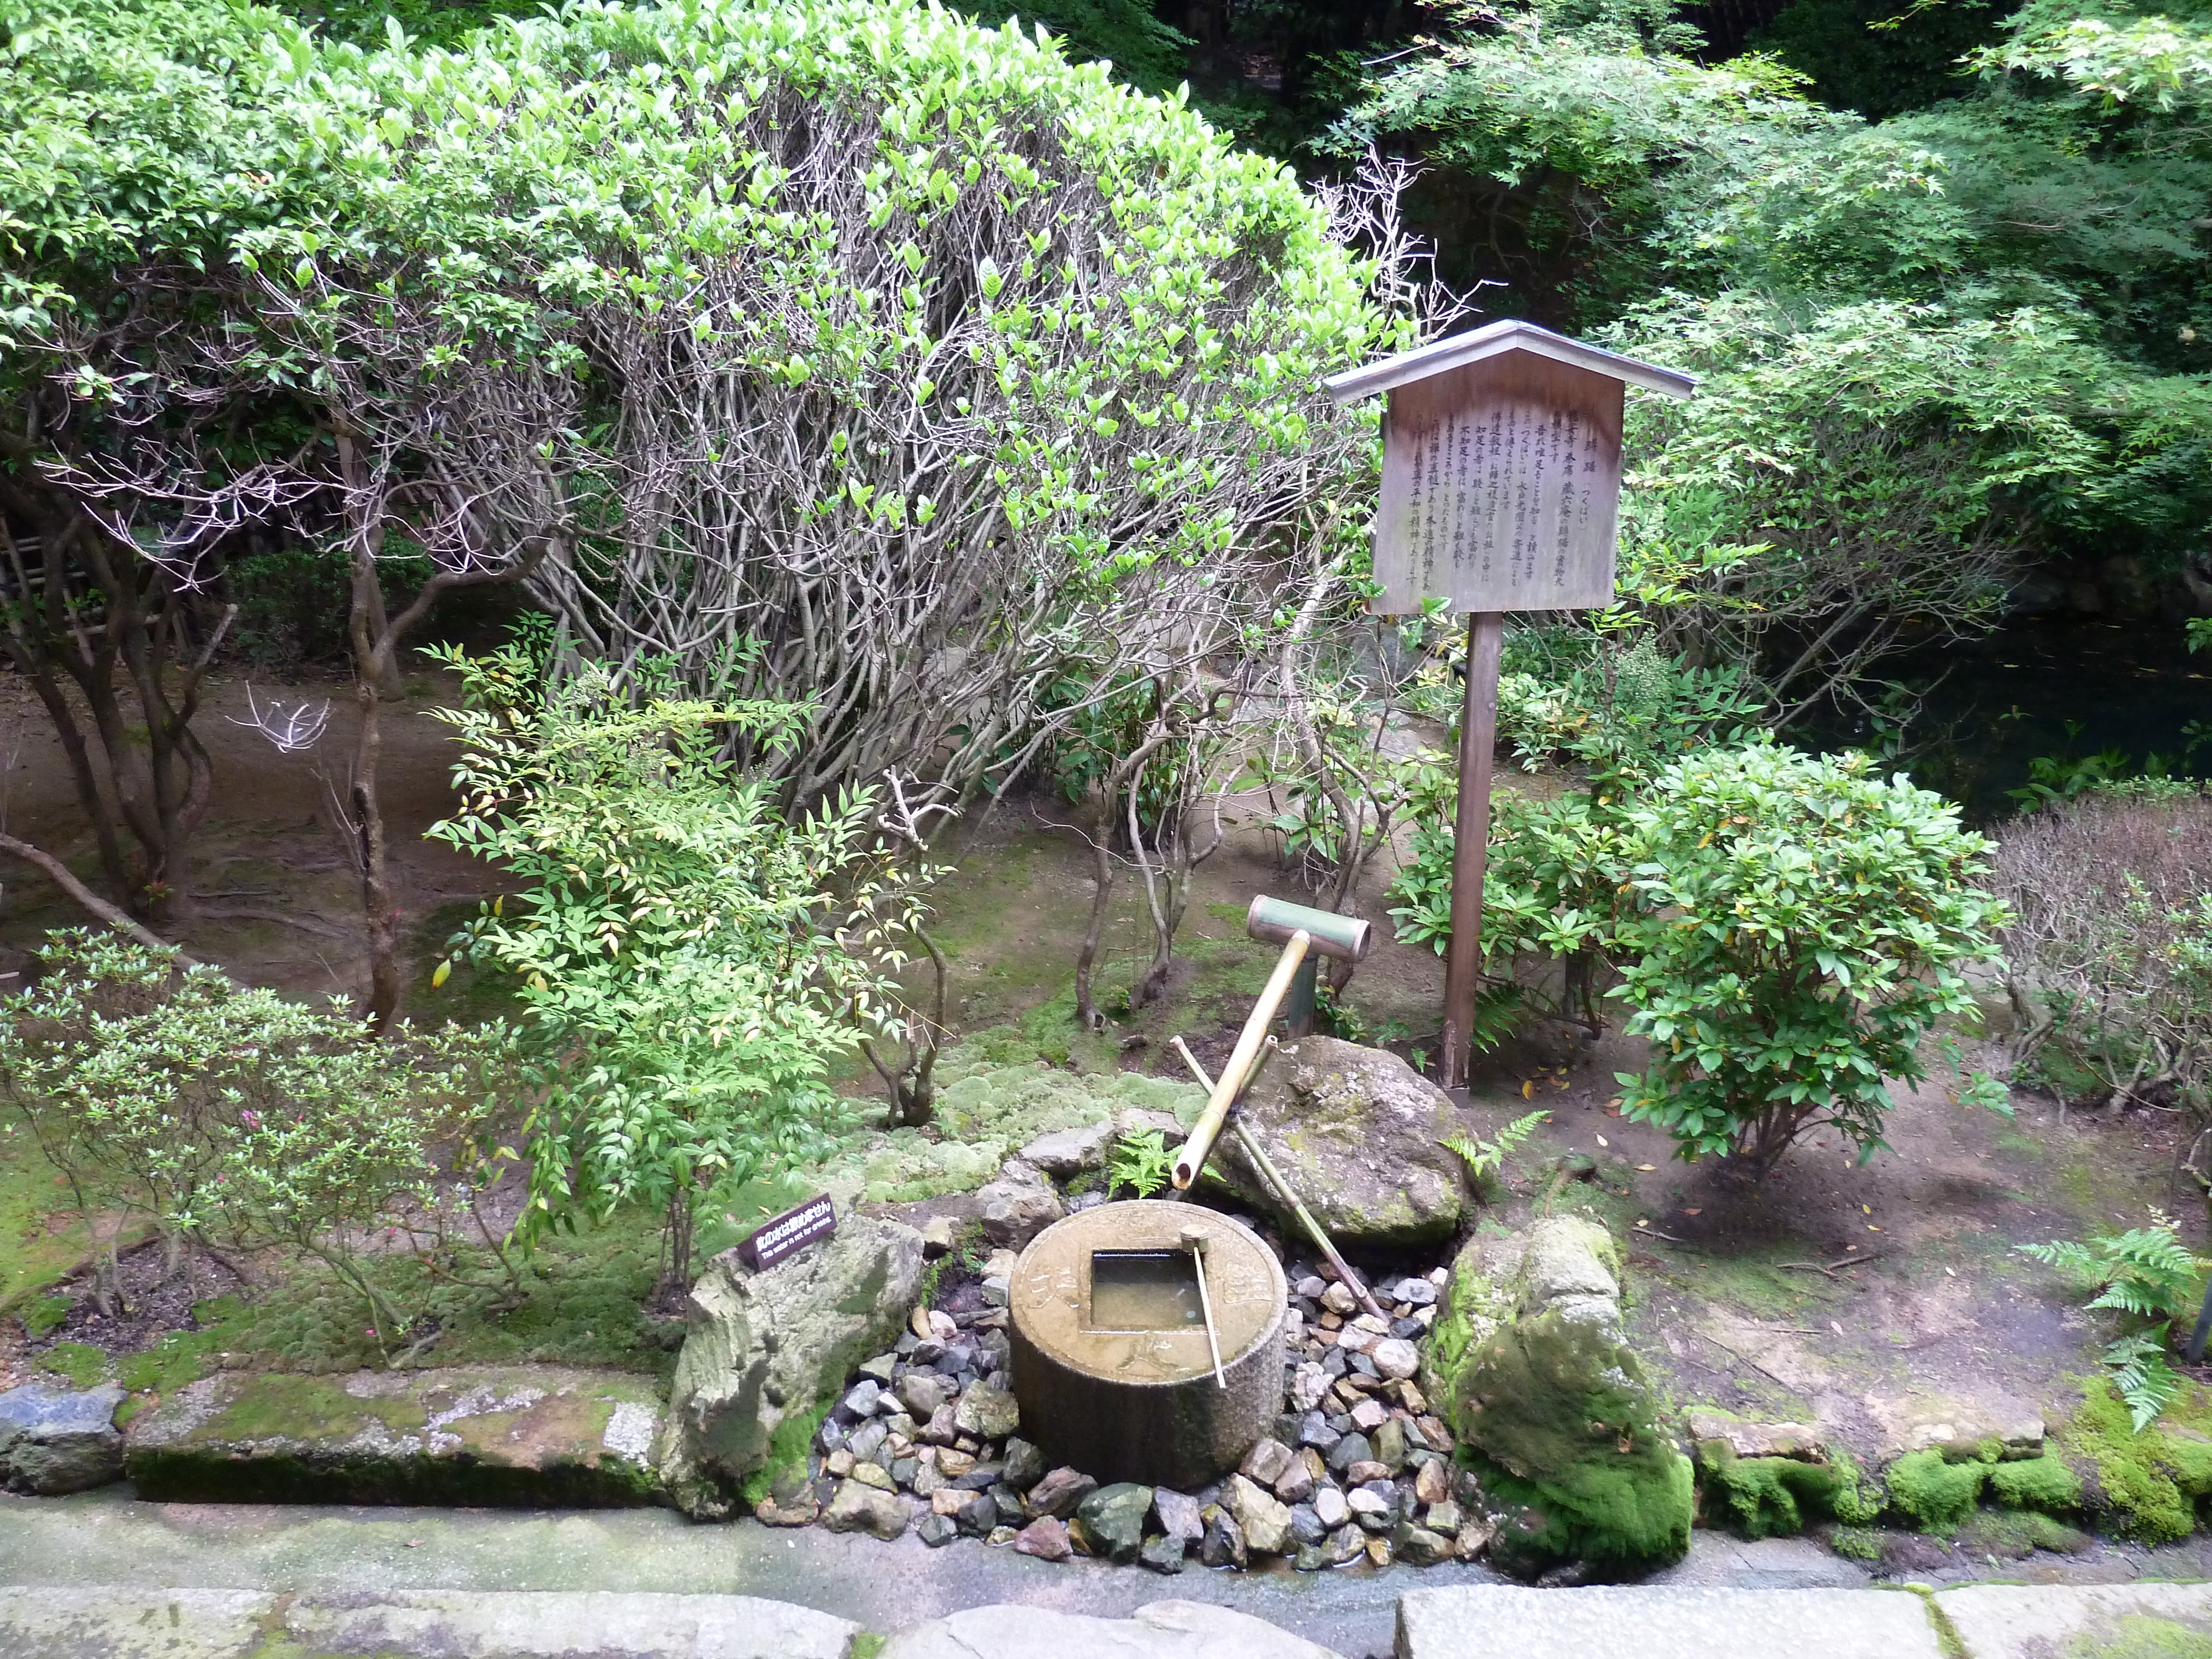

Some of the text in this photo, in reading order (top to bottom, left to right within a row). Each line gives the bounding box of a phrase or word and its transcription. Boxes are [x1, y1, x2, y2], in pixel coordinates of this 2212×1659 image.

[761, 1250, 774, 1260] This
[773, 1240, 788, 1253] water
[794, 1232, 804, 1241] not
[803, 1227, 812, 1235] for
